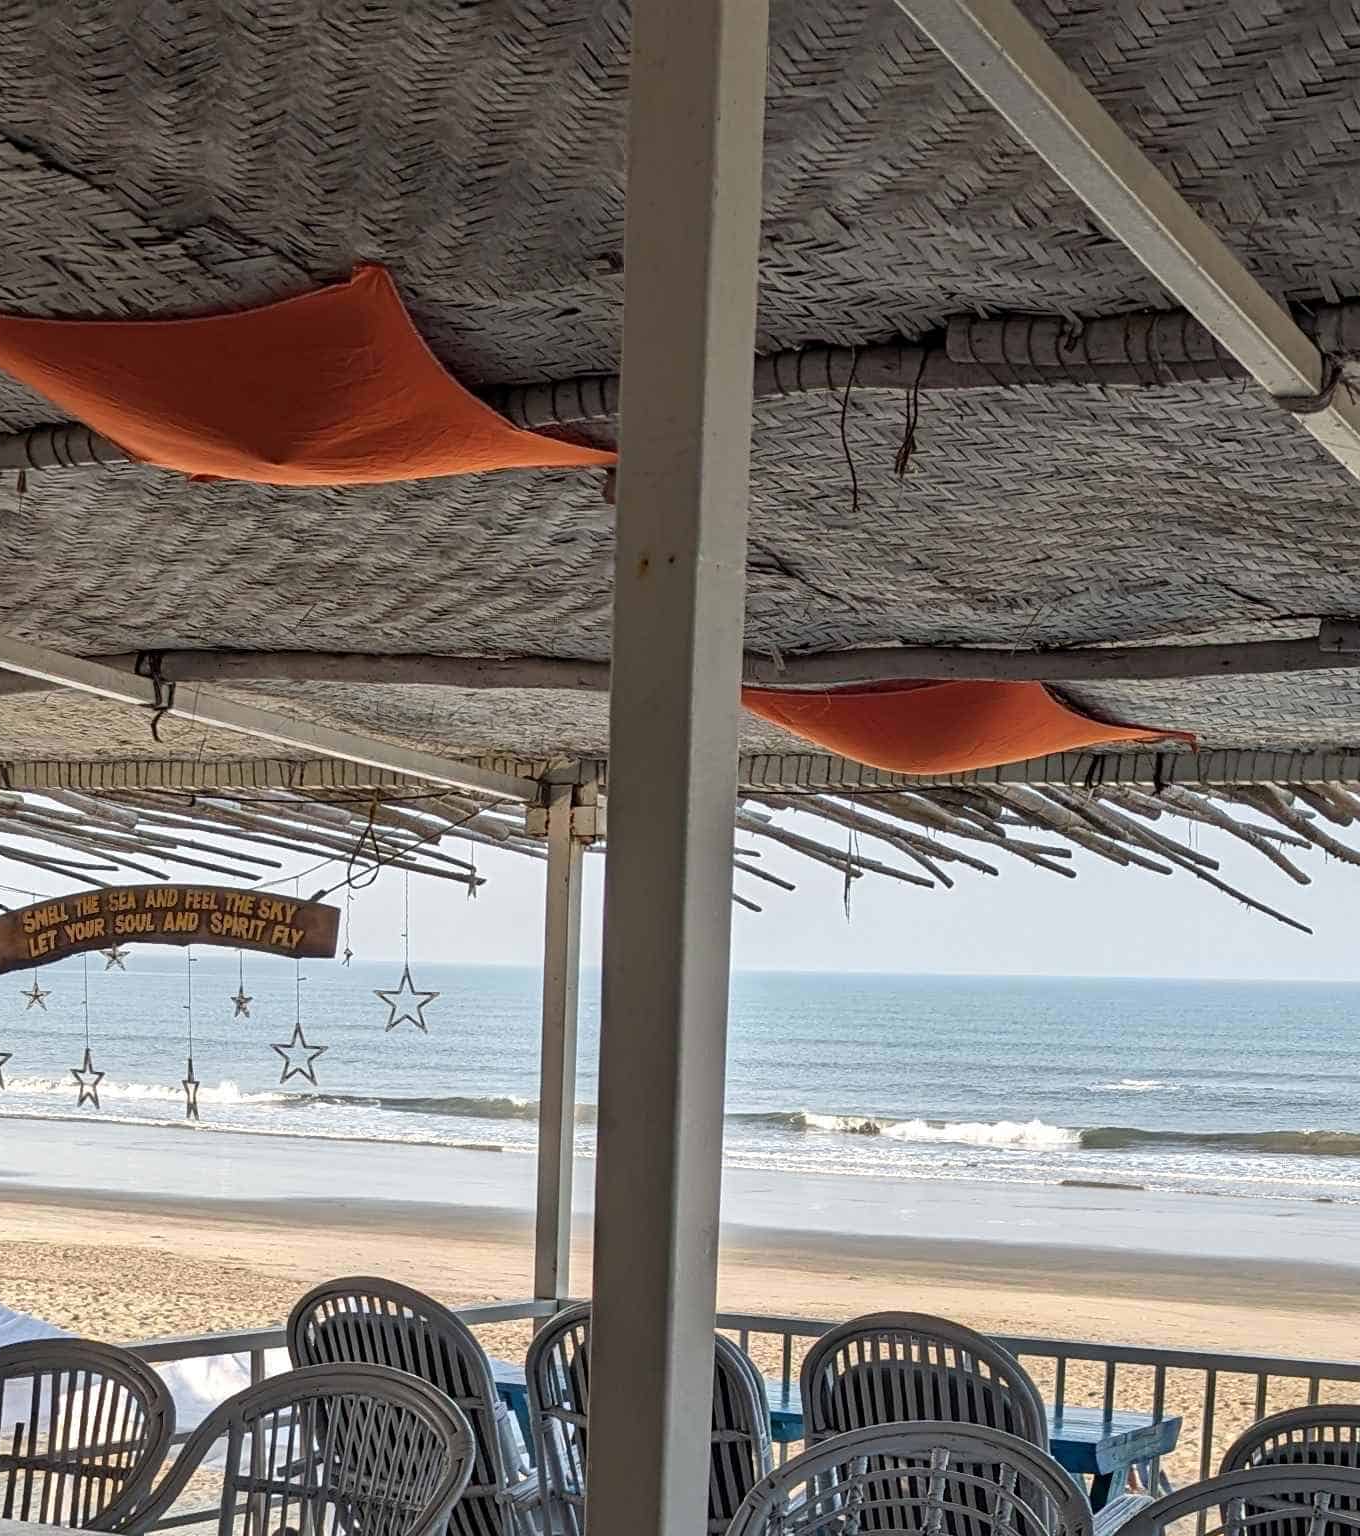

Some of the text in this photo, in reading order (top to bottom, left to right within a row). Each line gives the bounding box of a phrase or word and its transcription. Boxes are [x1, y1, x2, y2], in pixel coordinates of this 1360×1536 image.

[22, 888, 298, 933] SMELL THE SEA AND FEEL THE SKY
[29, 911, 305, 958] LET YOUR SOUL AND SPIRIT FLY
